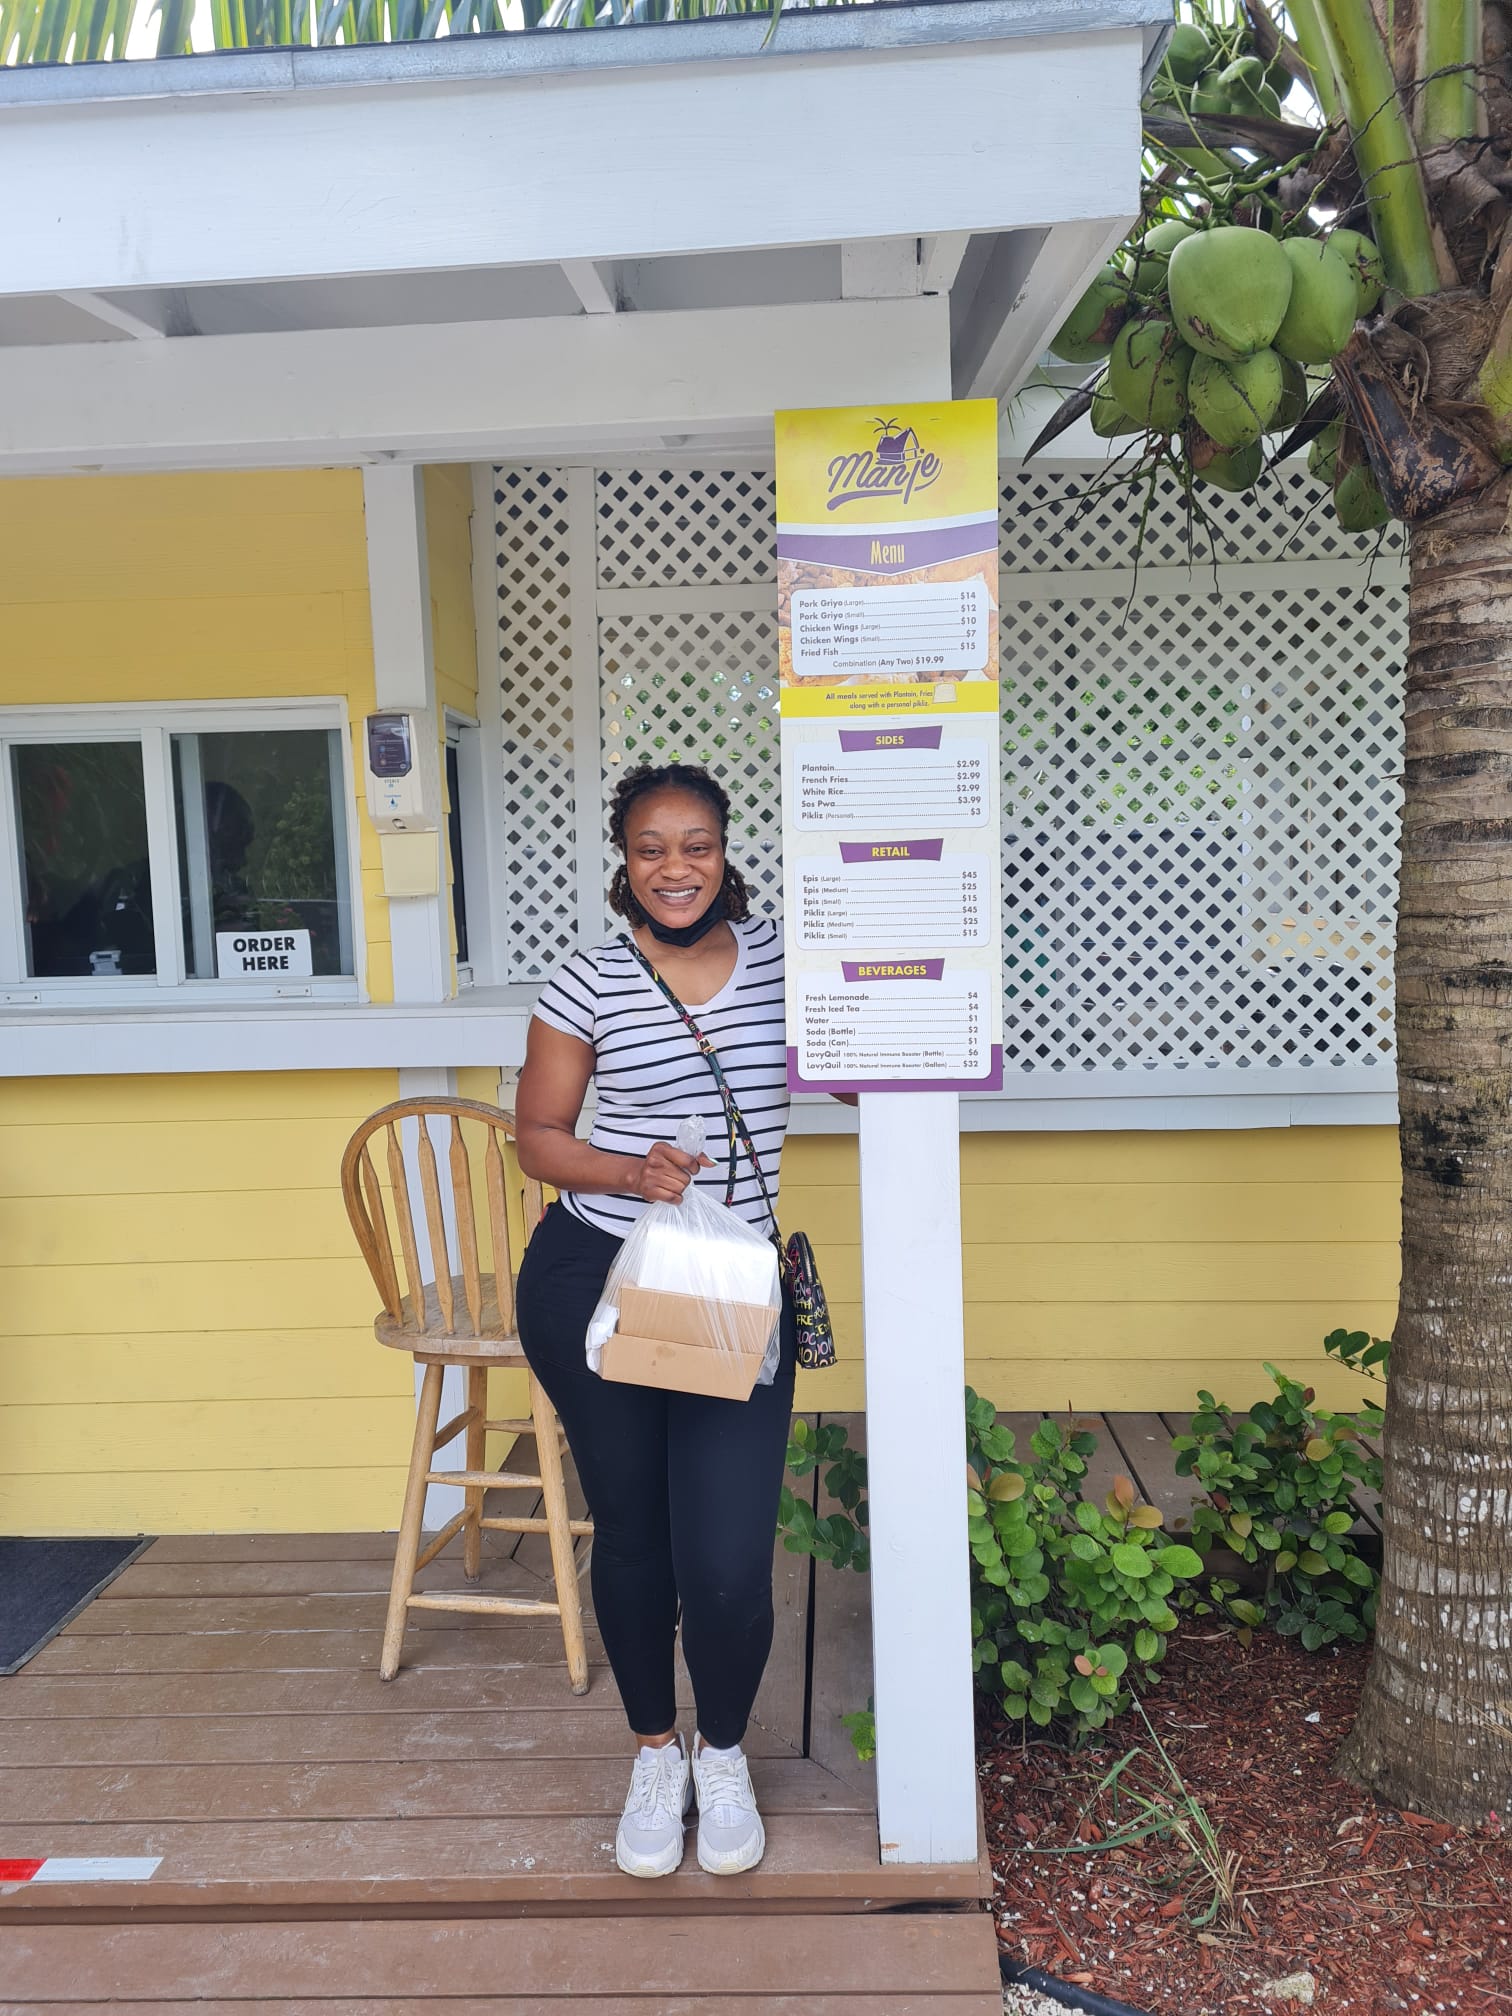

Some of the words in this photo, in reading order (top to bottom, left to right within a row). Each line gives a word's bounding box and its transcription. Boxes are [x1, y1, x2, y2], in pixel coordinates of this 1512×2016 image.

[827, 448, 943, 505] Manje
[870, 540, 905, 566] Menu
[799, 600, 818, 608] Pork
[960, 592, 976, 600] $14
[799, 612, 818, 620] Pork
[820, 611, 843, 620] Griyo
[961, 604, 976, 612] $12
[799, 624, 831, 633] Chicken
[833, 623, 859, 632] Wings
[961, 617, 976, 625] $10
[800, 636, 831, 645] Chicken
[833, 636, 859, 644] Wings
[966, 629, 976, 637] $7
[801, 648, 821, 656] Fried
[823, 647, 839, 656] Fish
[960, 642, 976, 650] $15
[832, 660, 876, 668] Combination
[878, 659, 895, 668] (Any
[896, 658, 913, 666] Two)
[915, 656, 944, 664] $19.99
[837, 692, 857, 700] meals
[859, 691, 879, 699] served
[850, 702, 866, 710] along
[887, 700, 912, 709] personal
[875, 735, 905, 745] SIDES
[802, 764, 835, 772] Plantain
[956, 760, 980, 768] $2.99
[830, 775, 848, 783] Fries
[957, 772, 981, 780] $2.99
[802, 788, 826, 796] White
[828, 787, 844, 795] Rice
[956, 784, 980, 792] $2.99
[958, 796, 981, 804] $3.99
[801, 811, 823, 819] Pikliz
[970, 808, 981, 816] $3
[871, 846, 910, 857] RETAIL
[803, 875, 818, 883] Epis
[962, 870, 977, 879] $45
[803, 886, 819, 895] Epis
[961, 882, 977, 890] $25
[803, 898, 819, 906] Epis
[962, 894, 977, 902] $15
[803, 909, 825, 917] Pikliz
[962, 906, 978, 914] $45
[803, 920, 825, 928] Pikliz
[963, 917, 978, 925] $25
[804, 931, 826, 939] Pikliz
[962, 929, 978, 937] $15
[233, 936, 296, 953] ORDER
[242, 955, 289, 971] HERE
[858, 965, 927, 976] BEVERAGES
[805, 994, 826, 1002] Fresh
[829, 993, 869, 1001] Lemonade
[968, 991, 978, 999] $4
[805, 1005, 826, 1013] Fresh
[968, 1003, 979, 1011] $4
[968, 1014, 978, 1022] $1
[806, 1028, 826, 1036] Soda
[828, 1027, 856, 1036] (Bottle)
[968, 1026, 978, 1034] $2
[806, 1039, 826, 1047] Soda
[828, 1039, 849, 1047] (Can)
[968, 1037, 978, 1045] $1
[806, 1050, 841, 1060] LovyQuil
[806, 1061, 841, 1071] LovyQuil
[922, 1061, 947, 1069] (Gallon)
[963, 1060, 978, 1068] $32
